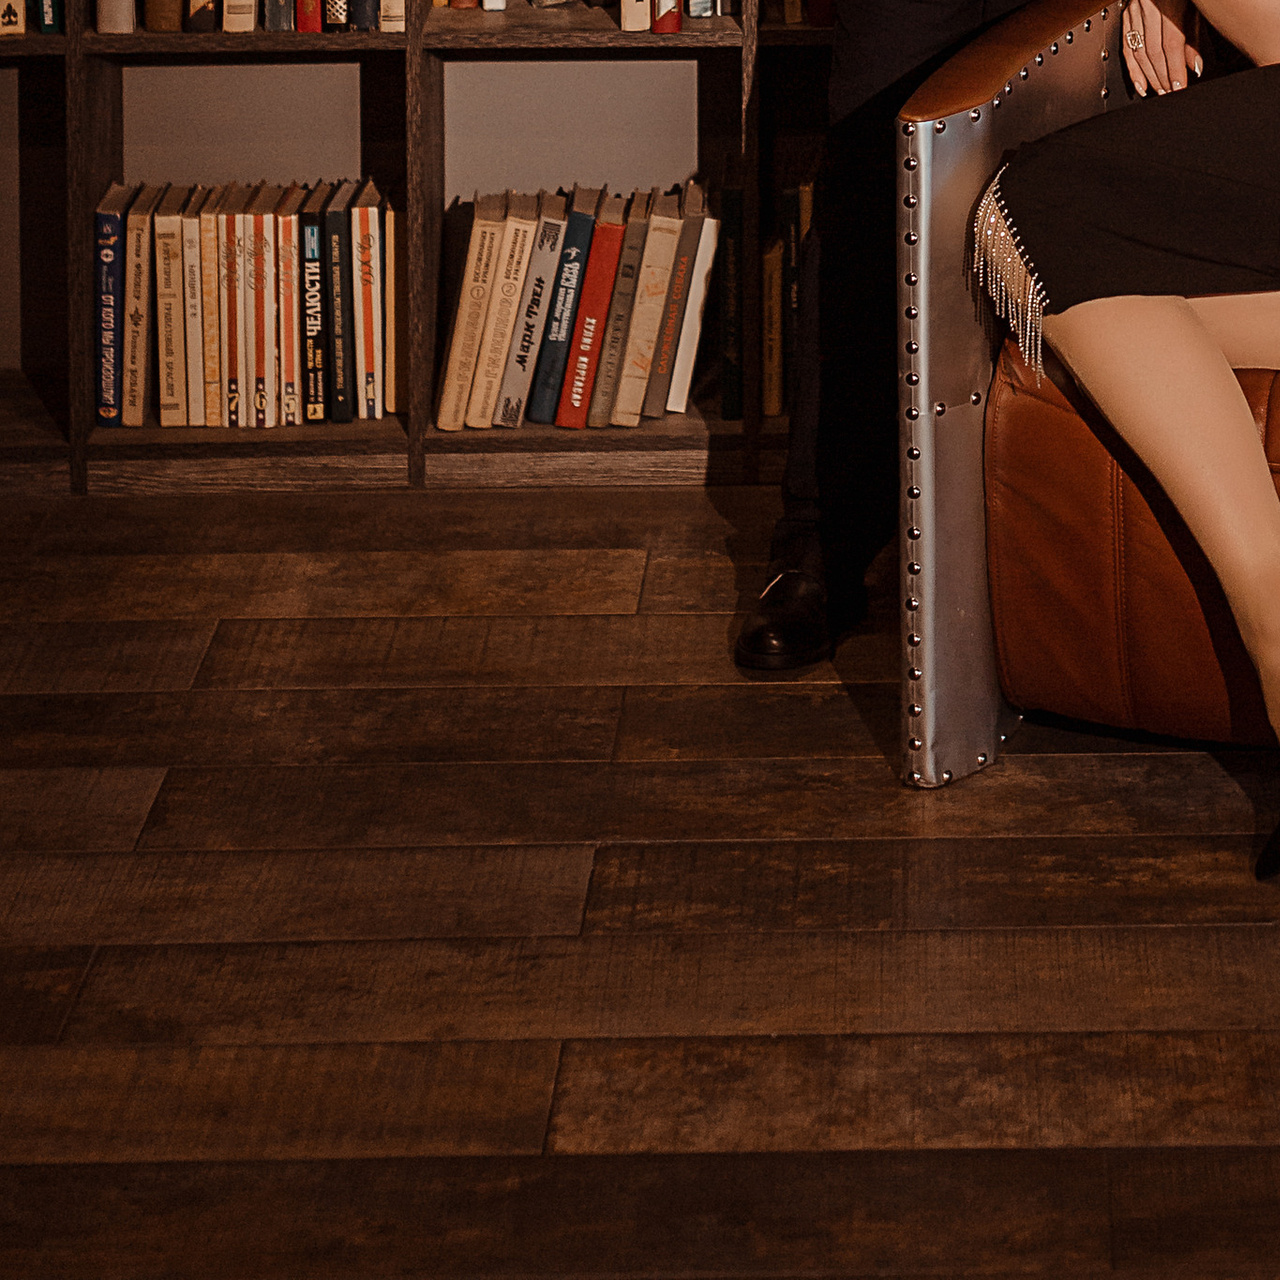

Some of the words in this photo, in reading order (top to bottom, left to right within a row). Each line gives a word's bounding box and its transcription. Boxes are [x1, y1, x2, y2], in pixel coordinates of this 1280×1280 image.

[305, 262, 321, 336] ЧЕЛЮСТИ
[515, 322, 535, 371] Марк
[526, 277, 544, 319] Твен
[658, 304, 678, 374] СЛУЖЕБНАЯ
[673, 256, 688, 300] СОБАКА
[572, 356, 591, 407] КОРТАСАР
